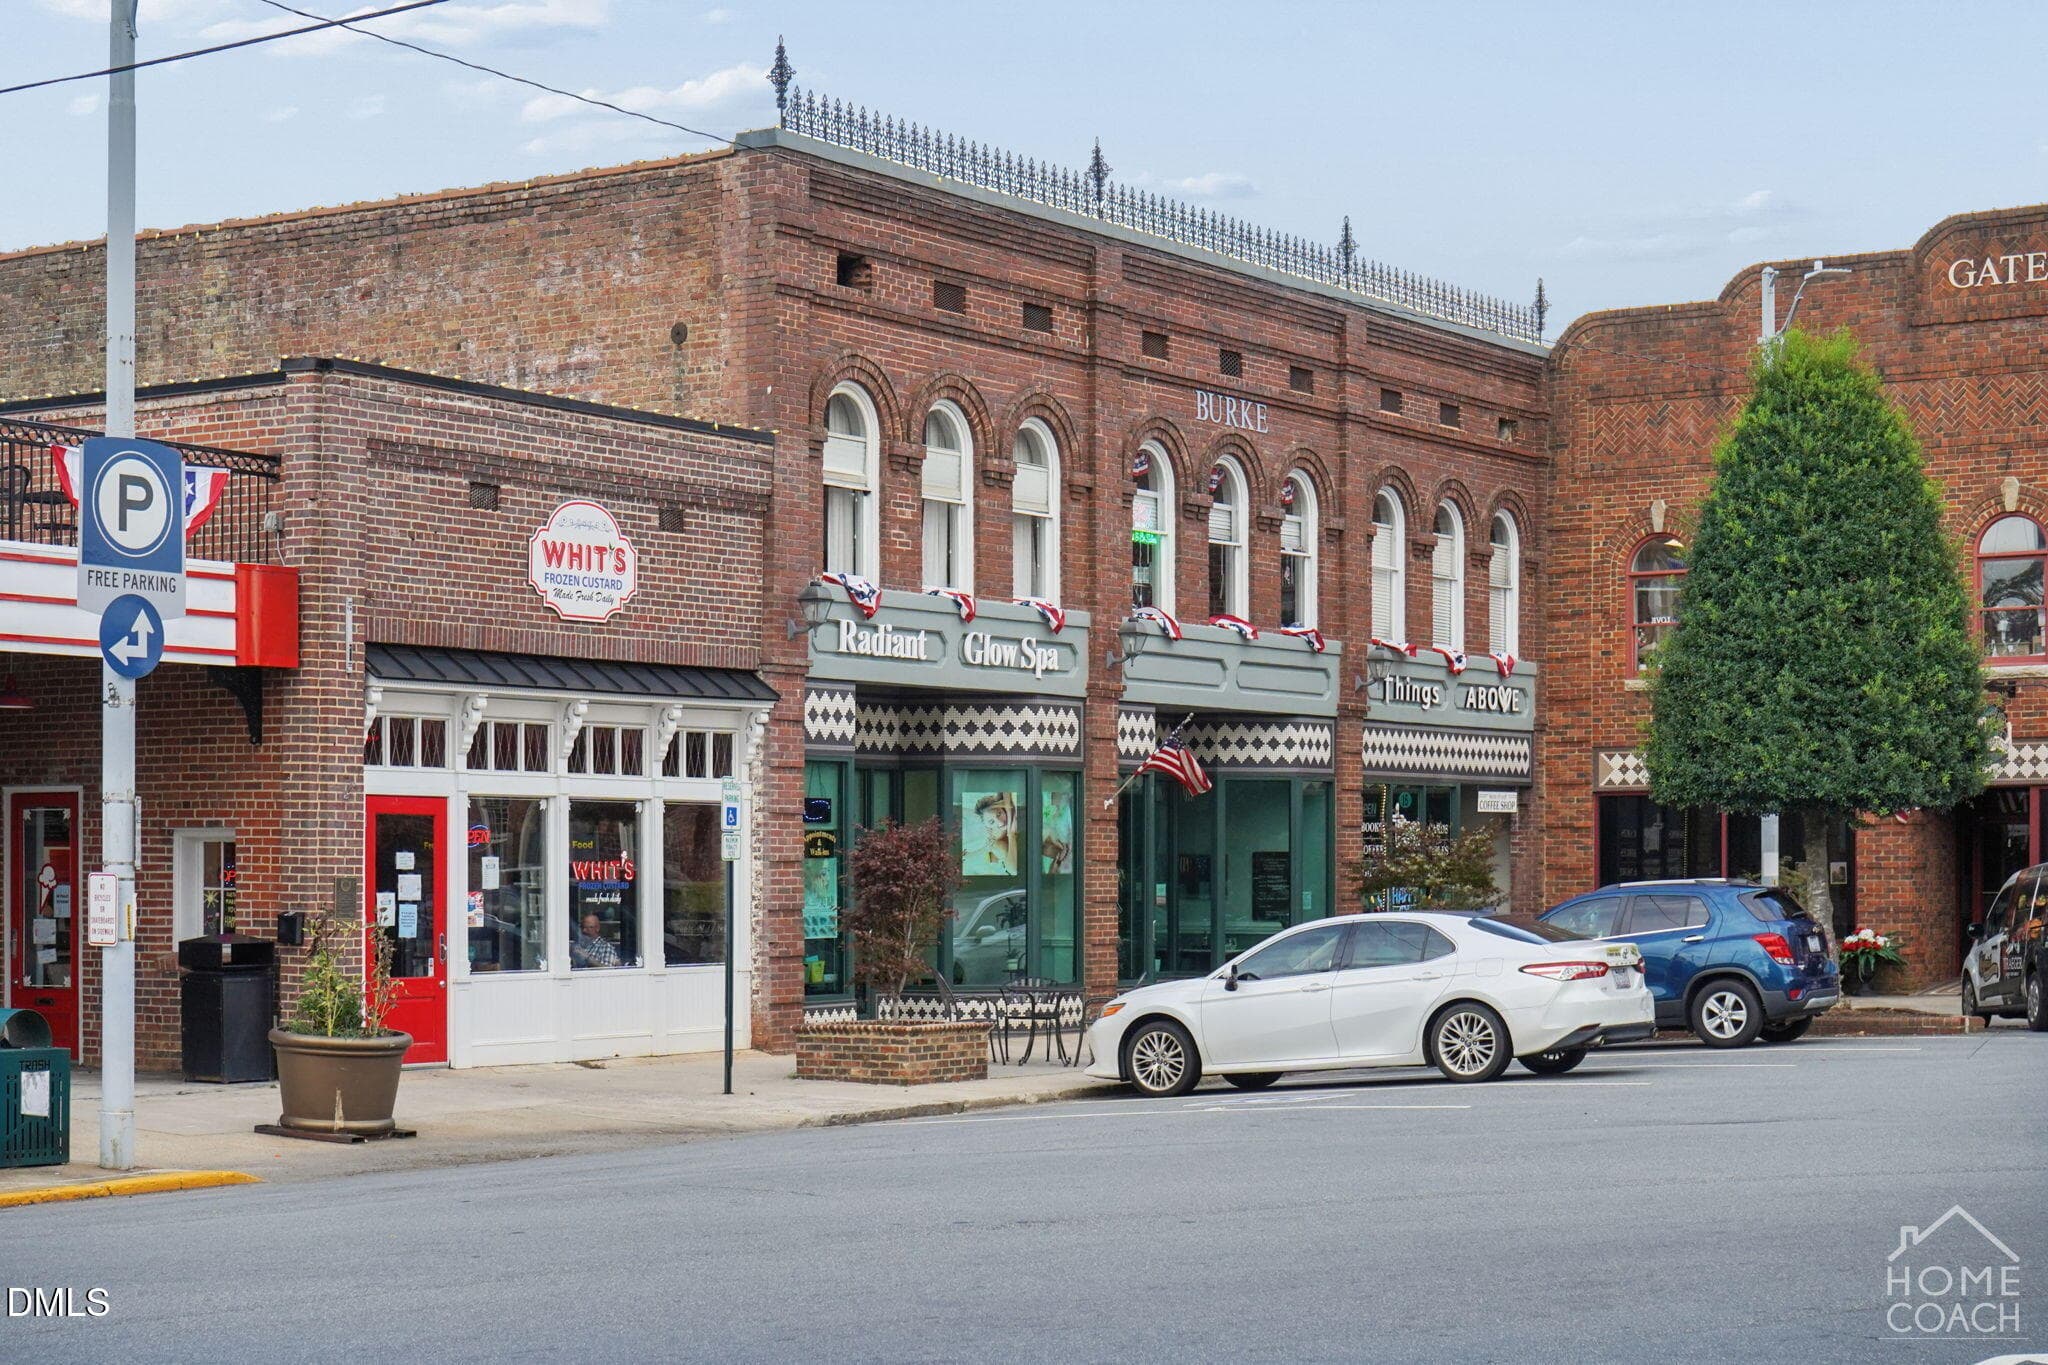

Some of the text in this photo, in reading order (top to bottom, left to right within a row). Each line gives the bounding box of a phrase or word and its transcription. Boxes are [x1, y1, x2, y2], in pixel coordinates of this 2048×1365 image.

[1196, 390, 1269, 433] BURKE
[118, 473, 154, 532] P
[541, 539, 627, 575] WHIT'S
[87, 570, 177, 593] FREE PARKING
[544, 572, 623, 590] FROZEN CUSTARD
[553, 588, 615, 606] Made Fresh Daily
[838, 619, 1060, 679] Radiant Glow Spa
[1363, 803, 1377, 814] PEN
[1480, 800, 1499, 810] COFFEE
[466, 829, 490, 844] PEN
[572, 840, 594, 849] Food
[572, 859, 636, 881] WHIT'S
[19, 1060, 50, 1071] TRASH
